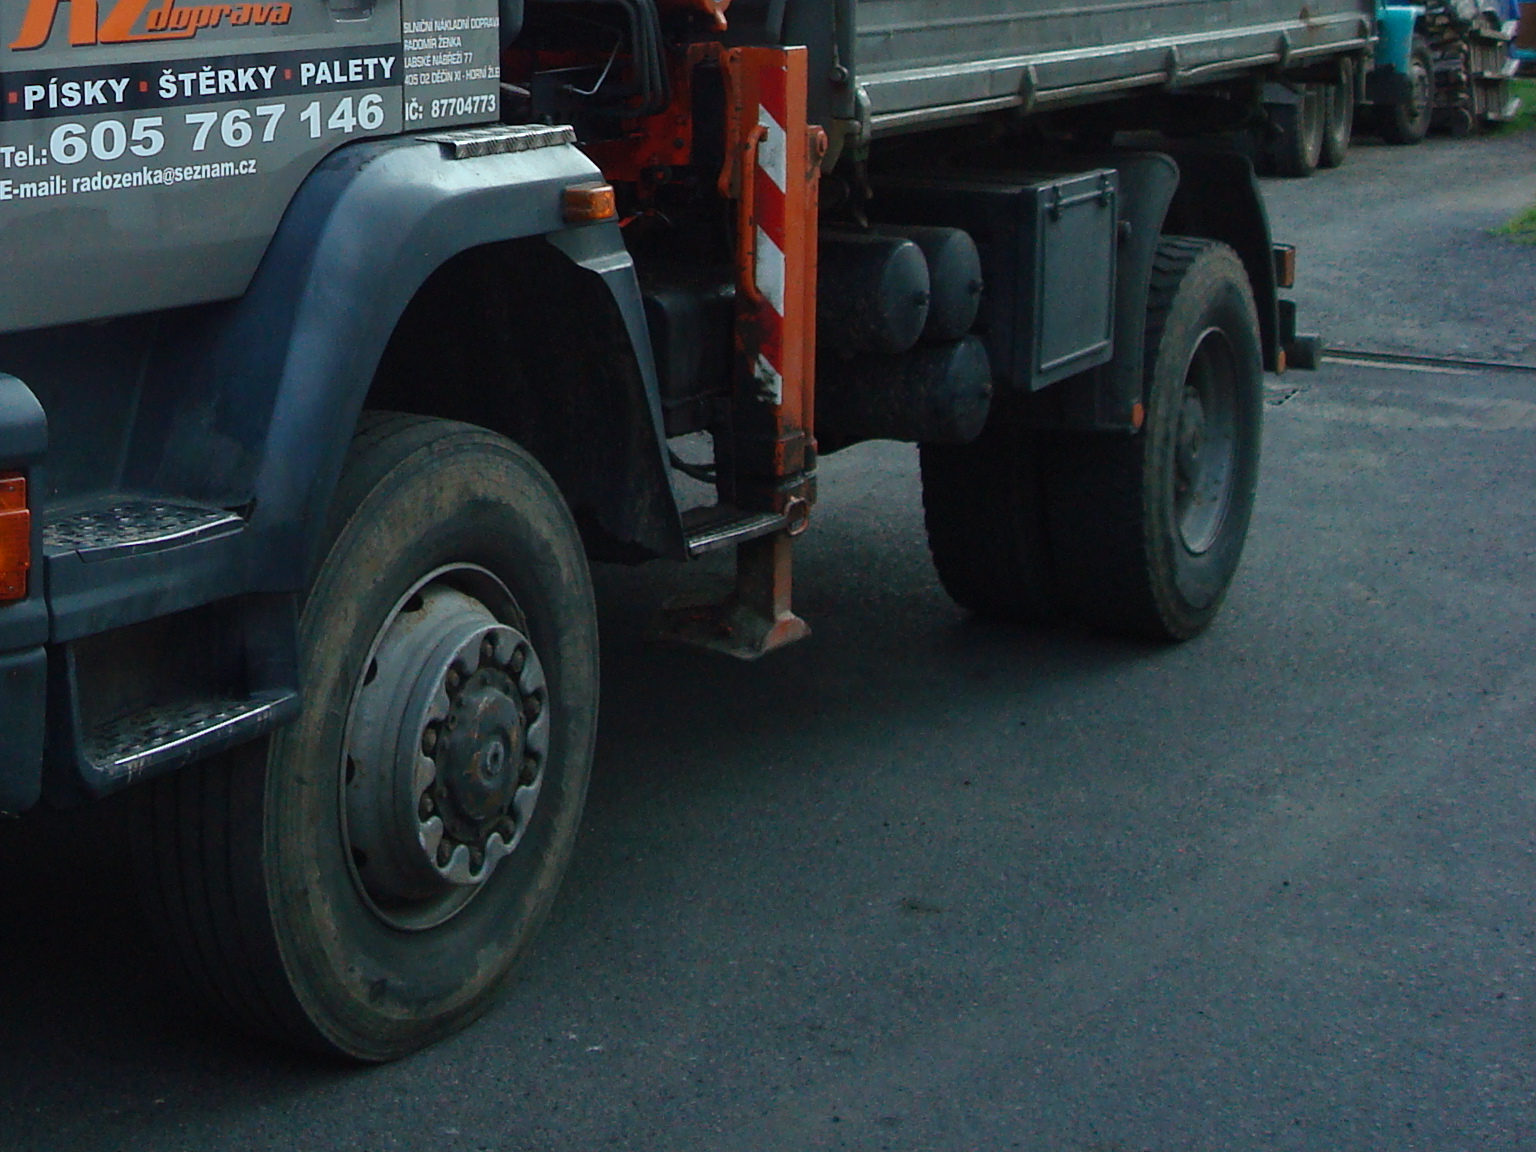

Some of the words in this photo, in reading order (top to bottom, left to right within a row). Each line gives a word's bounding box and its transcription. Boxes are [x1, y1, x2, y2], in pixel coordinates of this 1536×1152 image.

[23, 77, 130, 110] PÍSKY
[158, 65, 277, 99] ŠTĚRKY
[300, 56, 396, 86] PALETY
[0, 144, 48, 169] Tel.:
[50, 116, 165, 165] 605
[185, 103, 286, 152] 767
[299, 93, 385, 139] 146
[405, 97, 423, 121] IČ:
[431, 94, 496, 118] 87704773
[0, 174, 67, 201] E-mail:
[72, 158, 257, 193] radozenka@seznam.cz
